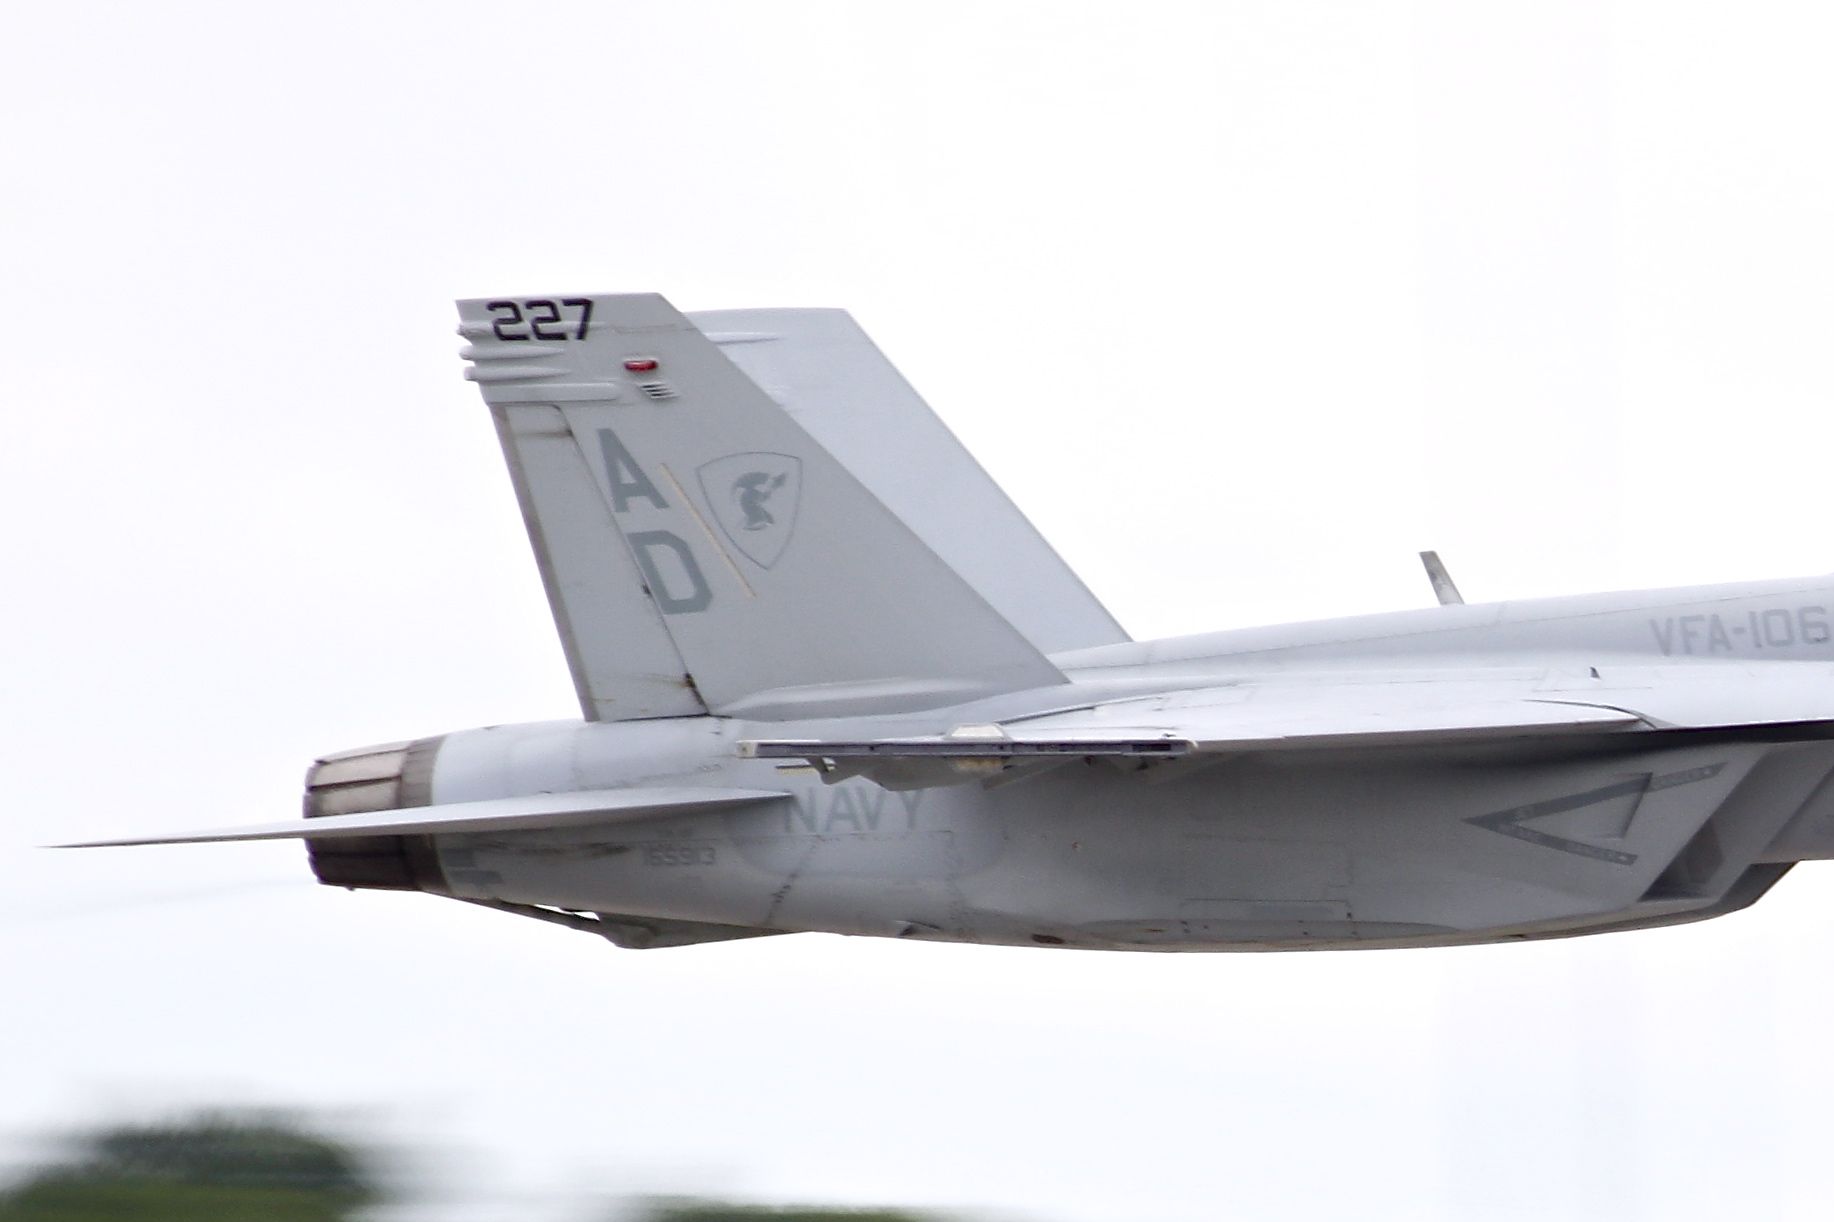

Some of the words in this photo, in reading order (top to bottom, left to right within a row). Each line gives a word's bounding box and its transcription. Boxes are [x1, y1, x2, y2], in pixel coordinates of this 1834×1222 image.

[486, 298, 593, 341] 227
[597, 427, 670, 513] A
[626, 529, 714, 616] D
[1649, 605, 1832, 657] VFA-106
[784, 786, 925, 833] NAVY
